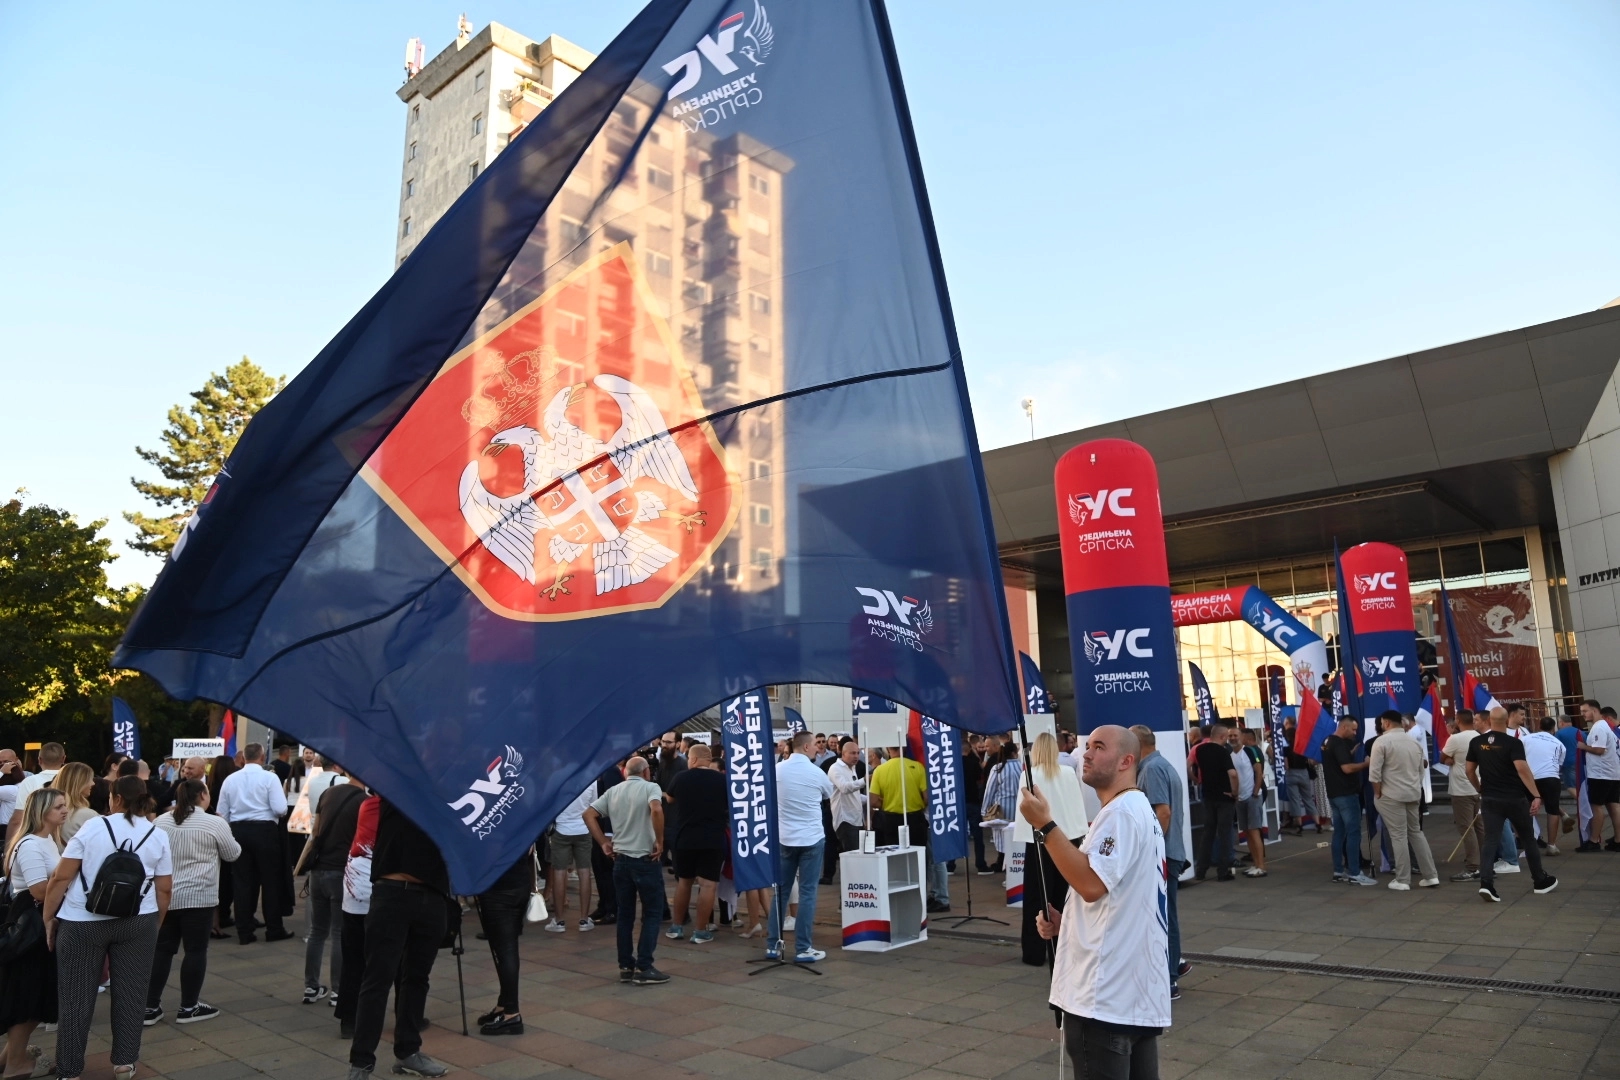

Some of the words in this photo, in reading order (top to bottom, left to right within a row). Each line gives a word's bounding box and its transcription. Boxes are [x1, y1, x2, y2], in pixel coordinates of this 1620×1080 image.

[1075, 487, 1136, 520] УС
[1079, 529, 1133, 543] УЈЕДИЊЕНА
[1079, 538, 1135, 554] СРПСКА
[1360, 572, 1397, 591] УС
[1579, 567, 1620, 586] КУЛТУР
[1360, 596, 1395, 604] УЈЕДИЊЕНА
[1361, 601, 1396, 611] СРПСКА
[1261, 608, 1298, 649] УС
[1091, 628, 1154, 660] УС
[1367, 655, 1406, 675] УС
[1460, 650, 1503, 665] ilmski
[1094, 671, 1150, 682] УЈЕДИЊЕНА
[1467, 664, 1505, 678] stival
[1095, 680, 1152, 695] СРПСКА
[1369, 684, 1405, 695] СРПКА
[847, 883, 877, 891] ДОБРА,
[848, 892, 878, 900] ПРАВА,
